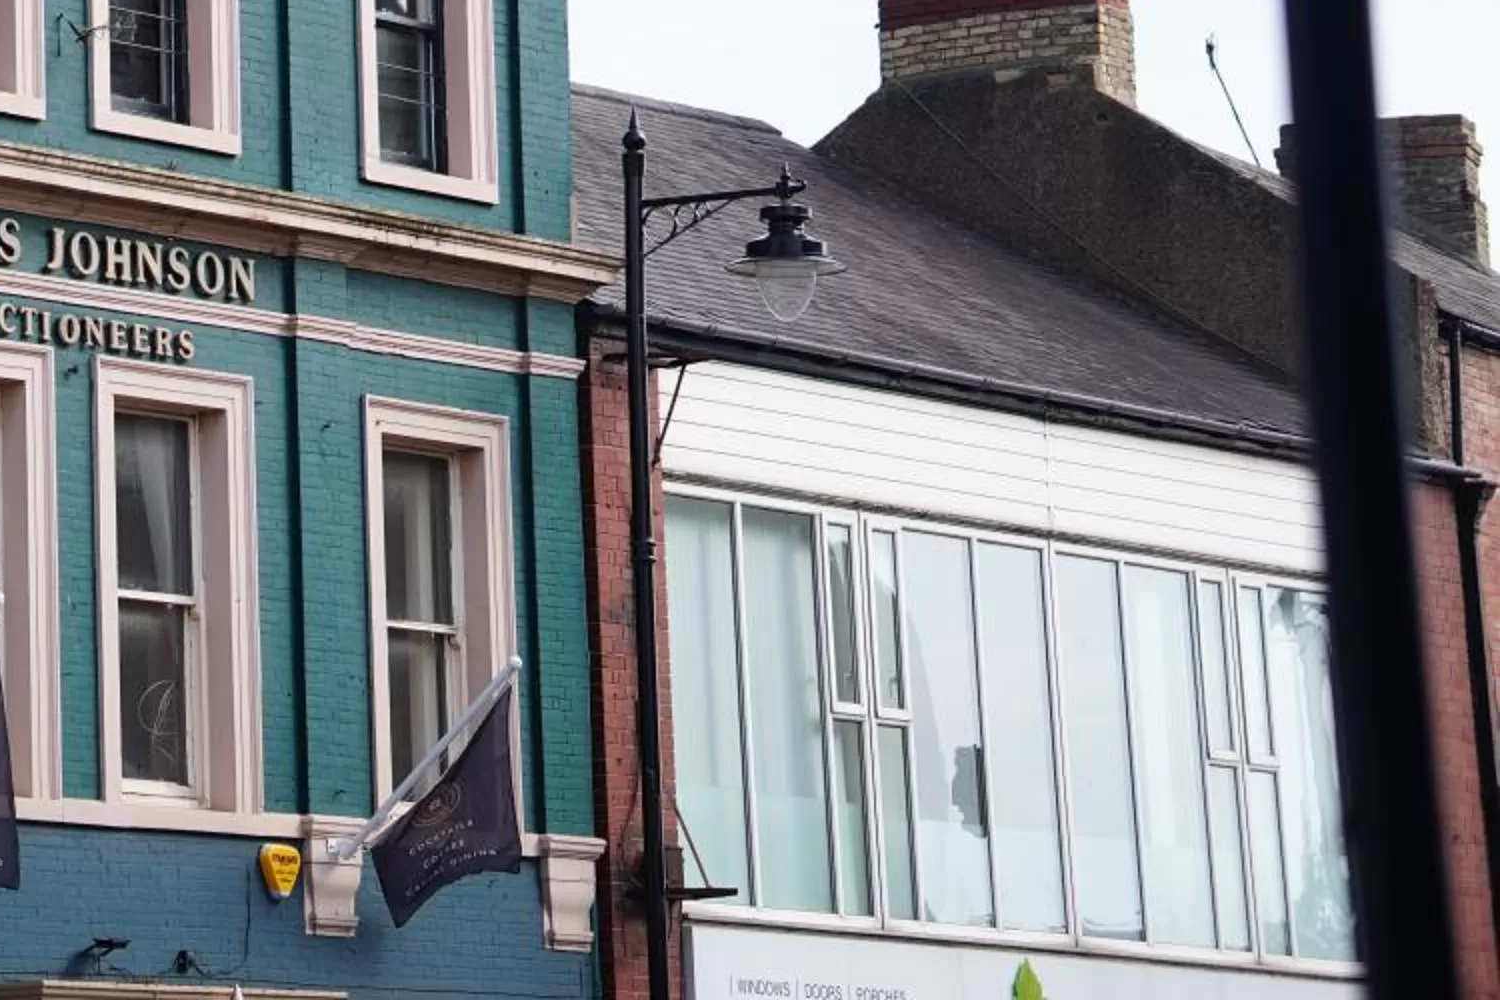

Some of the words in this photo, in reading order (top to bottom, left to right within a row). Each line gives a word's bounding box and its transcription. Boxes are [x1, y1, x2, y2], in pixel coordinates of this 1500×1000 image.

[46, 227, 257, 301] JOHNSON
[737, 979, 791, 997] WINDOWS
[803, 983, 842, 1000] DOORS
